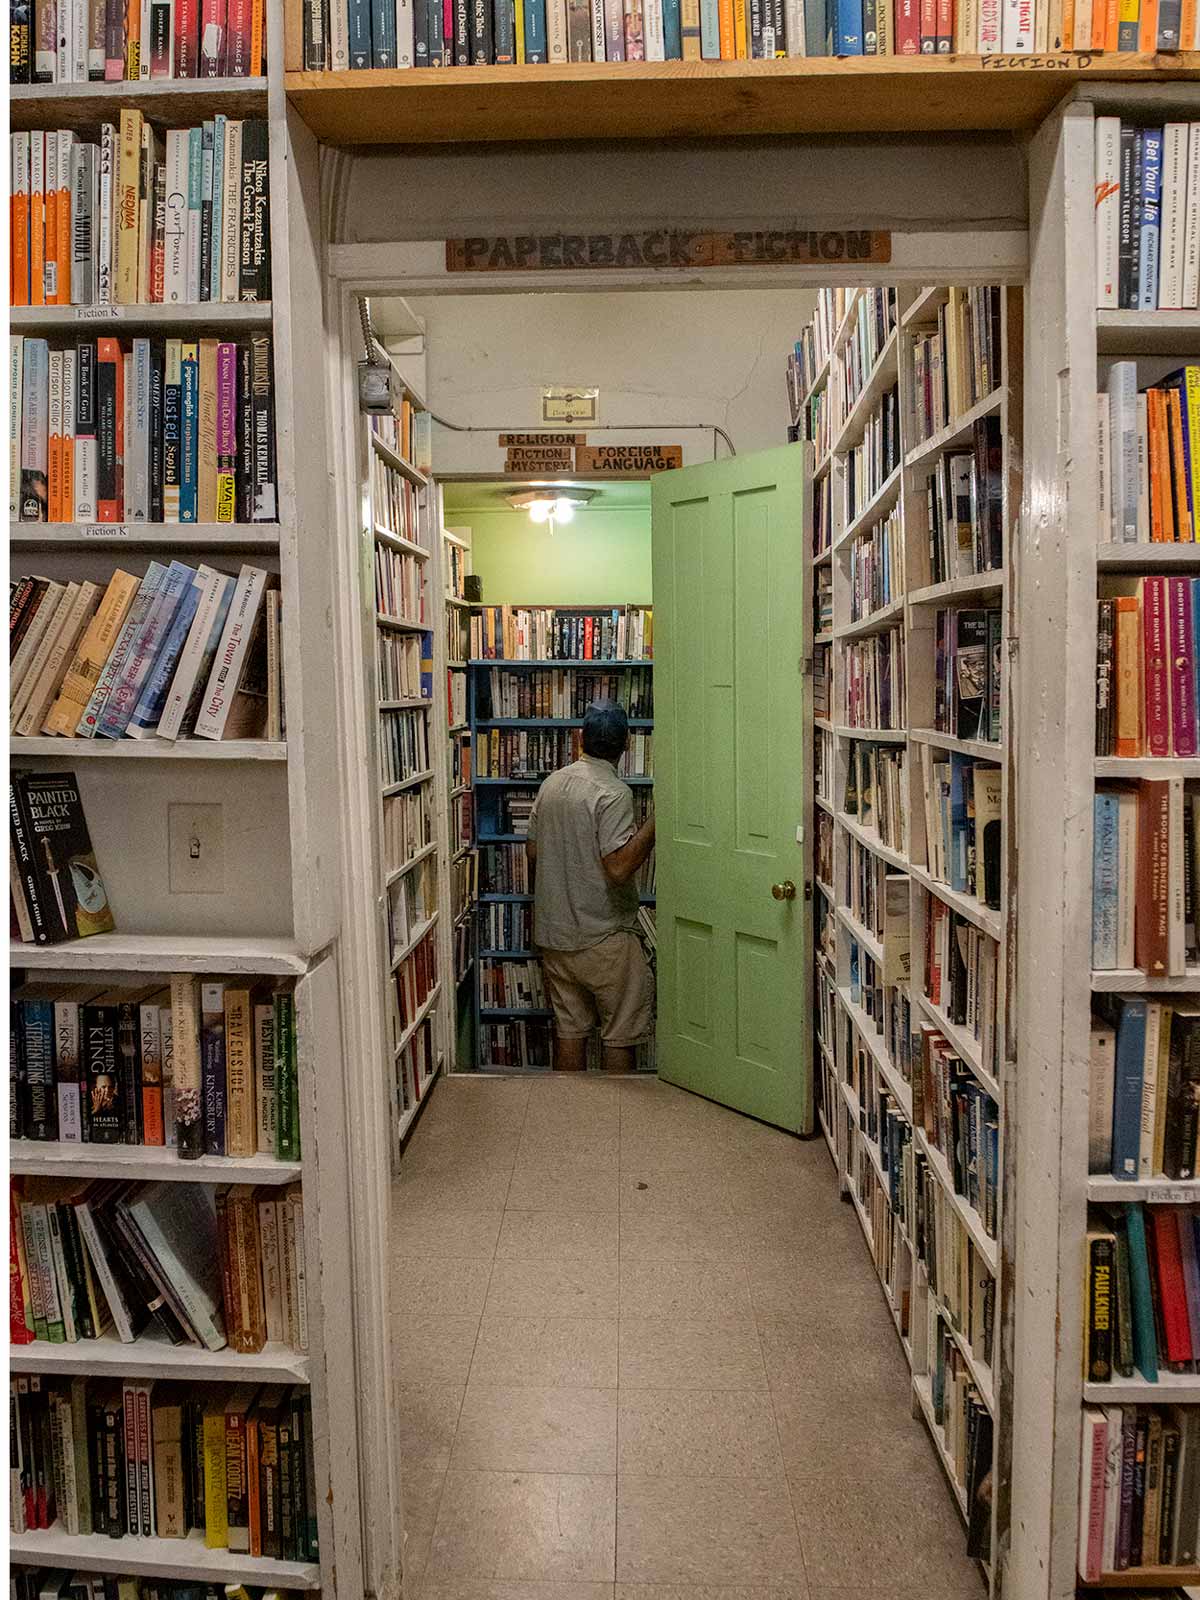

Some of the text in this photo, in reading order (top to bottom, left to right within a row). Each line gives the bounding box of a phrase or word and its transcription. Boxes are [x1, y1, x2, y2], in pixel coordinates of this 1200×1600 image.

[457, 13, 467, 46] Destiny
[475, 17, 485, 38] Tales
[595, 15, 604, 47] DINESEN
[611, 20, 620, 41] Dinh
[751, 13, 761, 37] WORLD
[981, 24, 998, 42] FAIR
[9, 24, 21, 67] KAHN
[180, 36, 188, 68] PASSAGE
[235, 31, 244, 64] PASSAGE
[980, 54, 1093, 70] FICTION D
[1105, 133, 1113, 166] ROOM
[1172, 128, 1180, 156] RICHARD
[33, 137, 41, 186] JAN KARON
[48, 136, 56, 185] JAN KARON
[242, 159, 255, 183] The
[1143, 139, 1159, 221] Bet Your Life
[122, 184, 136, 230] NEDJMA
[226, 125, 238, 278] Kazantzakis THE FRATRICIDES
[242, 185, 255, 221] Greek
[253, 160, 267, 266] Nikos Kazantzakis
[73, 214, 91, 264] MOVIOLA
[1121, 199, 1131, 244] TELESCOPE
[1189, 202, 1197, 241] CRITICAL
[242, 222, 255, 266] Passion
[463, 230, 872, 268] PAPERBACK FICTION
[153, 239, 165, 299] EXPOSED
[1145, 231, 1154, 293] RICHARD DOOLING
[76, 307, 119, 319] Fiction K
[80, 347, 89, 421] The Book of Guys
[221, 357, 231, 380] KENAN
[10, 358, 18, 440] OPPOSITE OF LONELINESS
[50, 355, 61, 427] Garrison Keillor
[63, 357, 73, 429] Garrison Keillor
[152, 369, 161, 409] COMEDY
[221, 382, 231, 395] LET
[106, 419, 113, 429] OF
[183, 366, 193, 484] pigeon english stephen kelman
[221, 408, 231, 430] DEAD
[256, 409, 268, 443] THOMAS
[242, 404, 251, 474] The Ladies of Lyndon
[506, 433, 577, 445] RELIGION
[513, 448, 563, 459] FICTION
[598, 446, 662, 458] FOREIGN
[81, 440, 89, 497] Garrison Keillor
[165, 445, 178, 483] Scotch
[511, 461, 569, 472] MYSTERY
[592, 457, 676, 470] LANGUAGE
[218, 476, 233, 520] UVA USED
[85, 525, 128, 537] Fiction K
[245, 570, 260, 590] JACK
[1152, 581, 1160, 616] DOROTHY
[230, 621, 244, 637] The
[1178, 619, 1186, 653] DUNNETT
[220, 634, 243, 666] Town
[205, 694, 225, 719] City
[212, 682, 226, 698] The
[1152, 704, 1160, 721] PLAY
[26, 789, 79, 805] PAINTED
[29, 803, 71, 820] BLACK
[15, 828, 29, 863] BLACK
[27, 875, 37, 901] GREG
[1158, 794, 1168, 937] THE BOOK OF EBENEZER LE PAGE
[25, 1020, 44, 1059] STEPHEN
[88, 1026, 105, 1073] KING
[103, 1025, 116, 1073] STEPHEN
[143, 1031, 154, 1066] KING
[230, 1012, 244, 1095] RAVENSHOE
[261, 1018, 275, 1091] WESTWARD HO!
[26, 1061, 45, 1085] KING
[92, 1115, 120, 1123] HEARTS
[206, 1073, 216, 1134] KINGSBURY
[215, 1090, 224, 1119] KAREN
[1142, 1081, 1155, 1135] Bloodroot
[1150, 1190, 1182, 1201] Fiction
[1094, 1264, 1111, 1331] FAULKNER
[128, 1463, 138, 1488] ARTHUR
[226, 1429, 242, 1500] DEAN KOONTZ
[140, 1463, 151, 1525] ARTHUR KOESTLER
